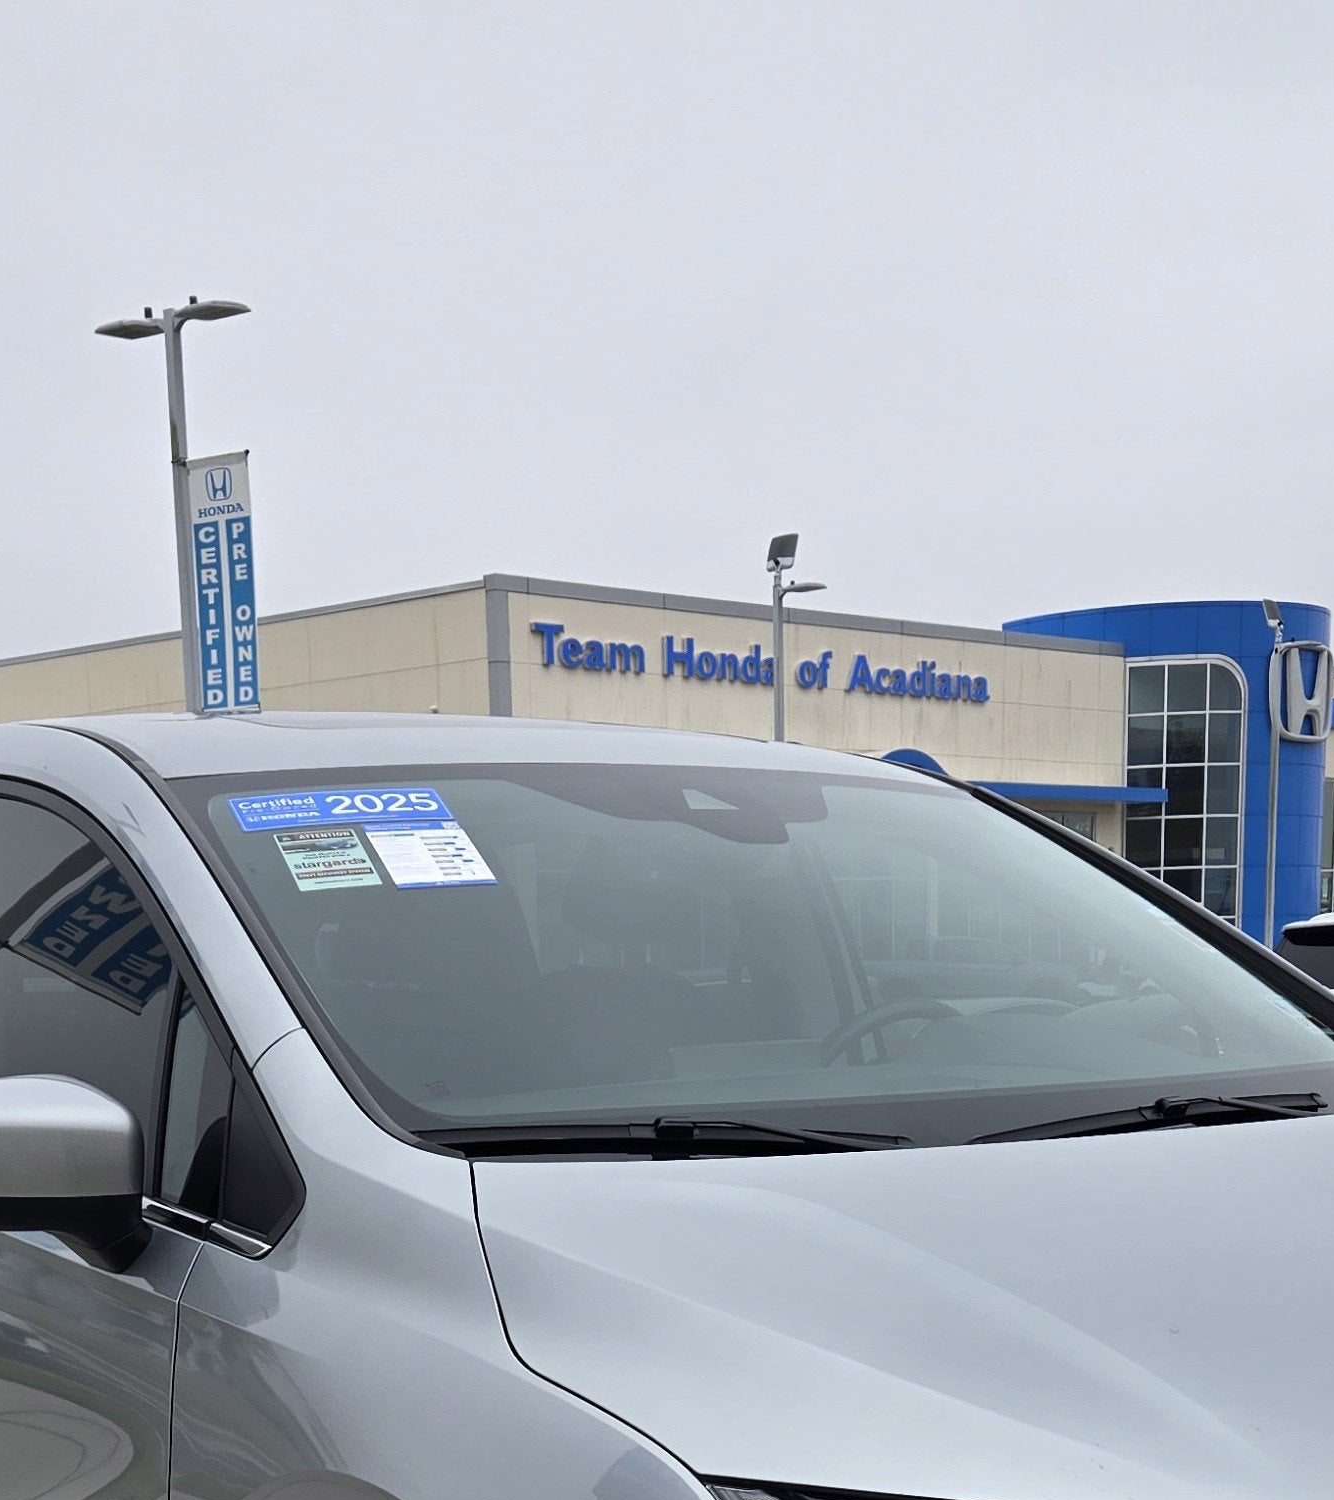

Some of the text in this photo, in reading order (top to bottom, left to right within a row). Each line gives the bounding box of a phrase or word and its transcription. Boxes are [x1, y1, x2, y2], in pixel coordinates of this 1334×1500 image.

[198, 503, 245, 518] HONDA
[198, 526, 224, 706] CERTIFIED
[232, 522, 254, 702] PRE OWNED
[533, 623, 990, 702] Team Honda of Acadiana
[238, 793, 439, 816] Certified 2025
[260, 811, 321, 821] HONDA
[298, 830, 351, 841] ATTENTION
